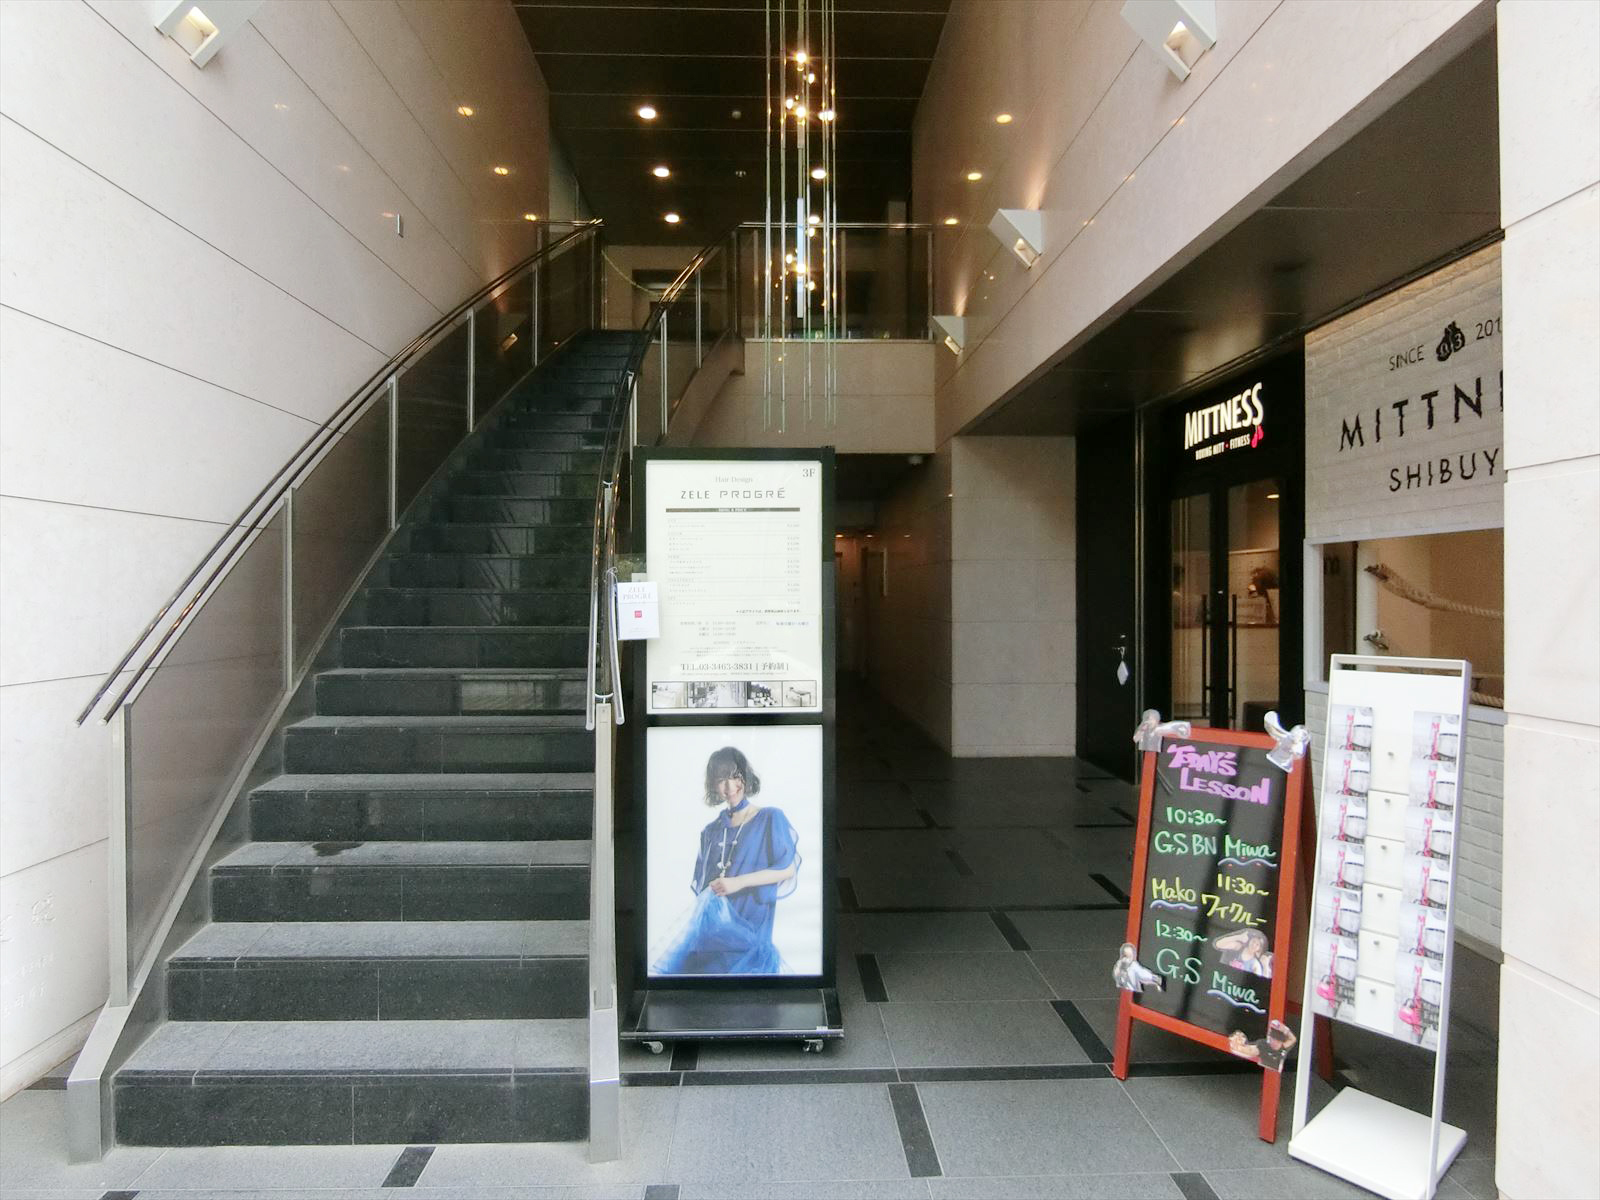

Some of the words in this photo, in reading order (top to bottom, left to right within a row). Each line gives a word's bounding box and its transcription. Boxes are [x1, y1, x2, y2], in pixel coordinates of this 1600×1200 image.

[1389, 344, 1425, 371] SINCE
[1184, 382, 1264, 450] MITTNESS
[1339, 370, 1504, 452] MITTN
[1229, 434, 1251, 450] FITNESS
[715, 475, 729, 483] Hair
[731, 475, 753, 484] Design
[802, 468, 816, 478] 3F
[680, 490, 710, 499] ZELE
[720, 487, 786, 499] PROGRÉ
[1180, 767, 1270, 805] LESSON
[1225, 834, 1277, 857] Miwa
[1152, 876, 1197, 903] Mako
[1211, 970, 1260, 1005] Miwa
